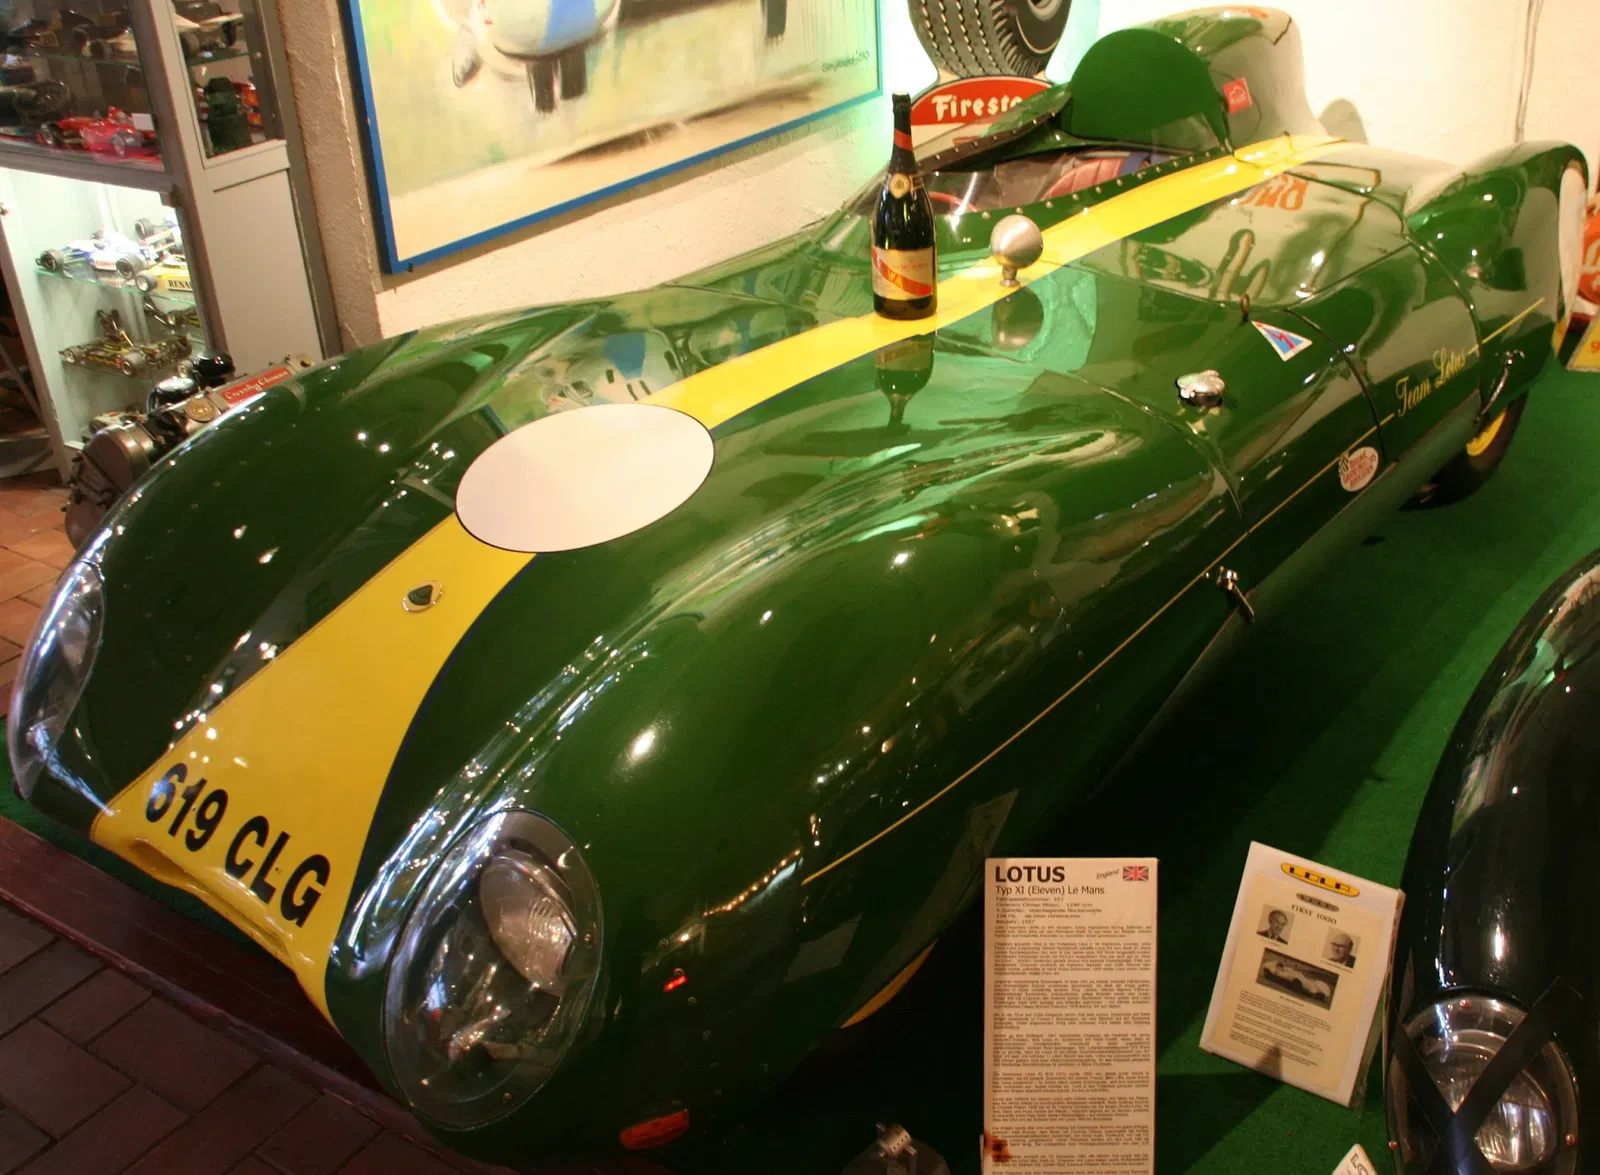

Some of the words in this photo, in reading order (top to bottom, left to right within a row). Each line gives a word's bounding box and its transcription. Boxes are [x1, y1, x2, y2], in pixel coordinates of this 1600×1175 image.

[931, 94, 1022, 122] Firesto
[1395, 375, 1432, 417] Team
[1433, 346, 1466, 389] Lotus
[145, 762, 229, 852] 619
[224, 815, 330, 928] CLG
[994, 866, 1065, 883] LOTUS
[1096, 868, 1120, 880] England
[996, 885, 1012, 897] Typ
[1014, 885, 1025, 894] XI
[1027, 885, 1065, 897] (Eleven)
[1067, 885, 1079, 895] Le
[1081, 885, 1105, 895] Mans
[1291, 904, 1313, 917] FIRST
[1316, 913, 1337, 925] 1000
